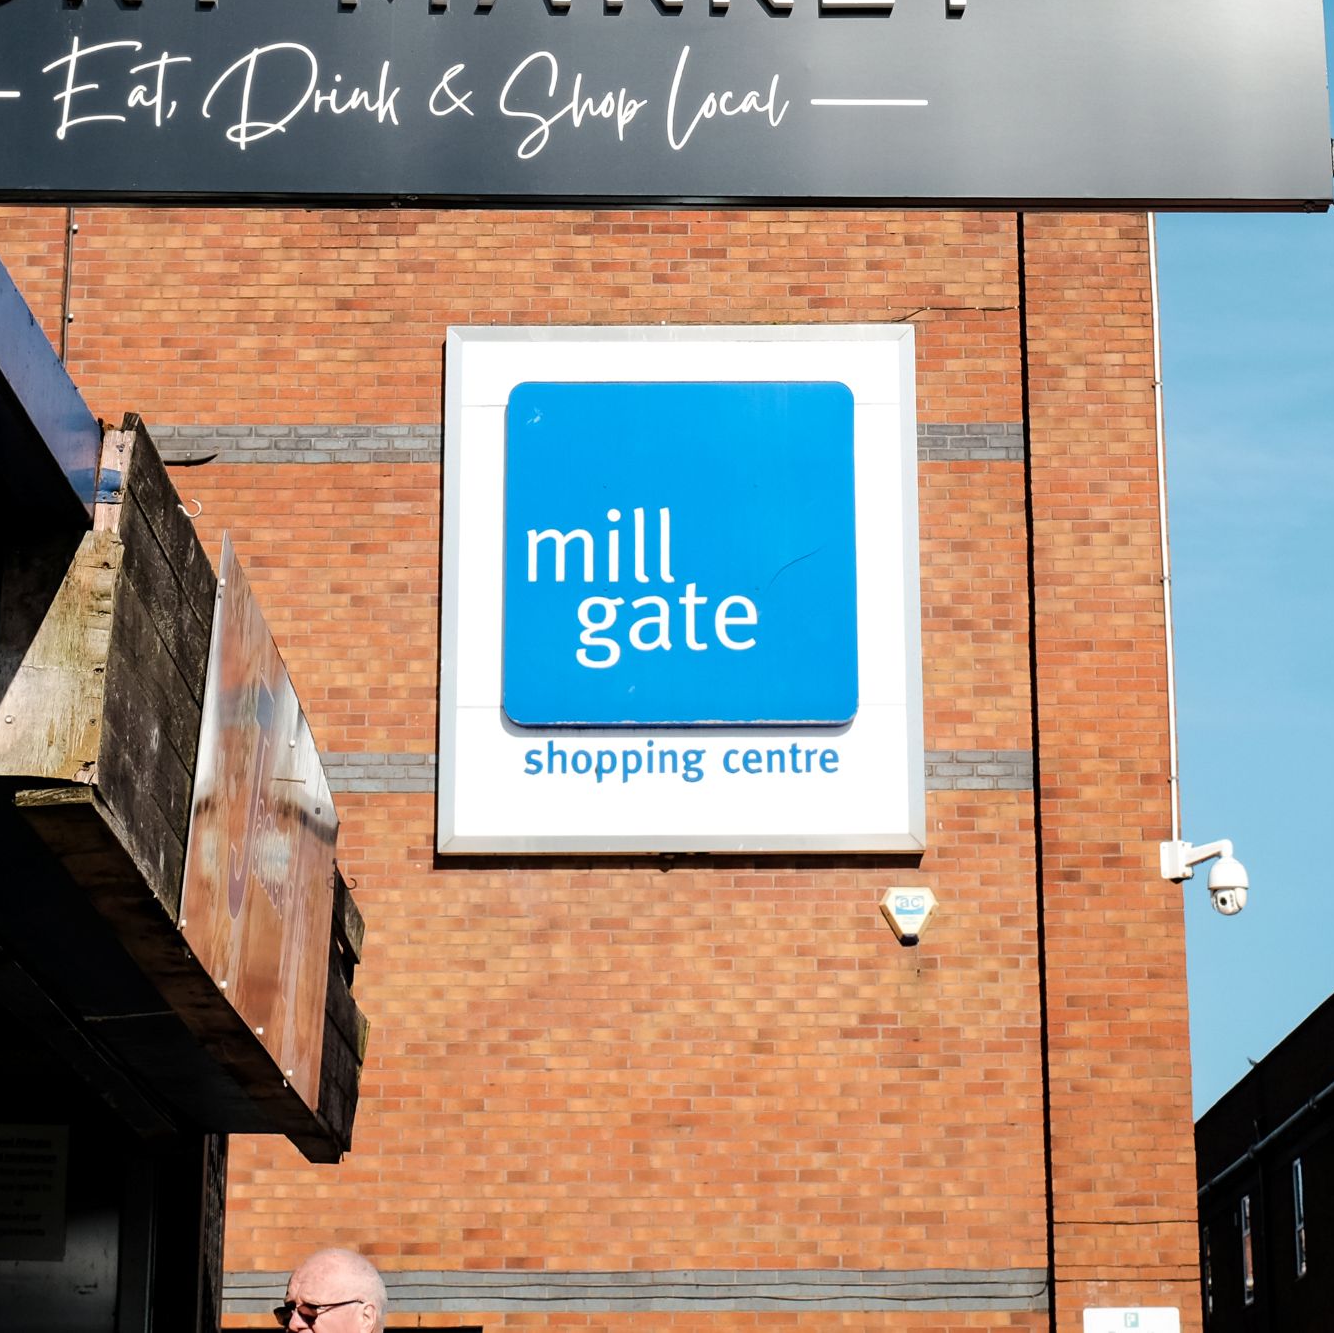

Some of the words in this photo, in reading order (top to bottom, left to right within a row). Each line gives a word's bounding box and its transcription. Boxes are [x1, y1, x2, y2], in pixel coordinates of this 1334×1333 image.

[42, 36, 191, 140] Eat,
[202, 42, 400, 150] Drink
[429, 64, 474, 116] &
[499, 50, 648, 159] Shop
[667, 45, 790, 150] Local
[528, 508, 674, 582] mill
[576, 582, 758, 668] gate
[525, 741, 704, 782] shopping
[723, 745, 838, 773] centre
